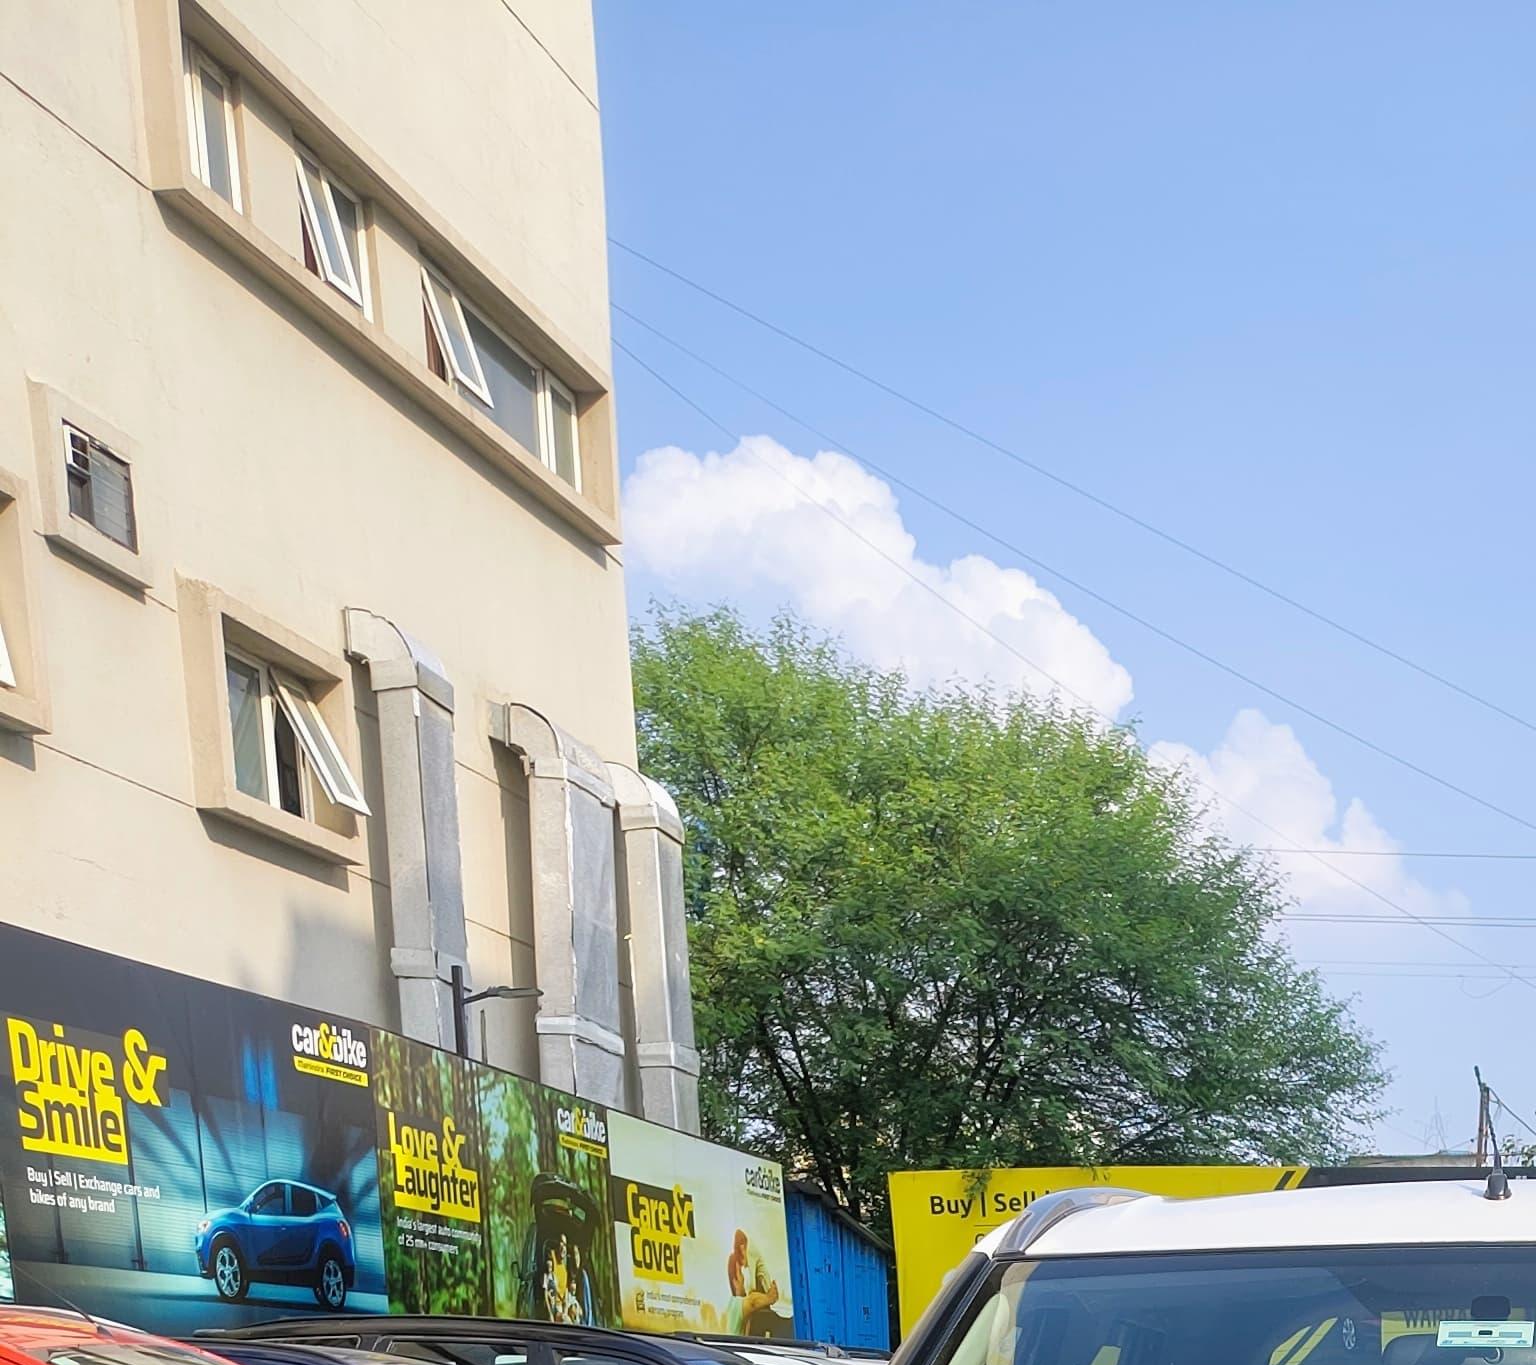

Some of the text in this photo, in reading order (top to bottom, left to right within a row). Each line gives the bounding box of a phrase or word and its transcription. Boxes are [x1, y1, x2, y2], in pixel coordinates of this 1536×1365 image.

[7, 1018, 167, 1107] Drive &
[291, 1022, 367, 1069] car&bike
[15, 1080, 122, 1153] Smile
[388, 1111, 465, 1169] Love &
[27, 1166, 47, 1188] Buy
[54, 1169, 72, 1187] Sell
[79, 1174, 122, 1197] Exchange
[123, 1183, 142, 1196] cars
[143, 1185, 160, 1199] and
[29, 1188, 115, 1213] bikes of any brand
[393, 1153, 477, 1211] Laughter
[930, 1195, 972, 1218] Buy
[627, 1183, 694, 1238] Care &
[630, 1226, 680, 1275] Cover
